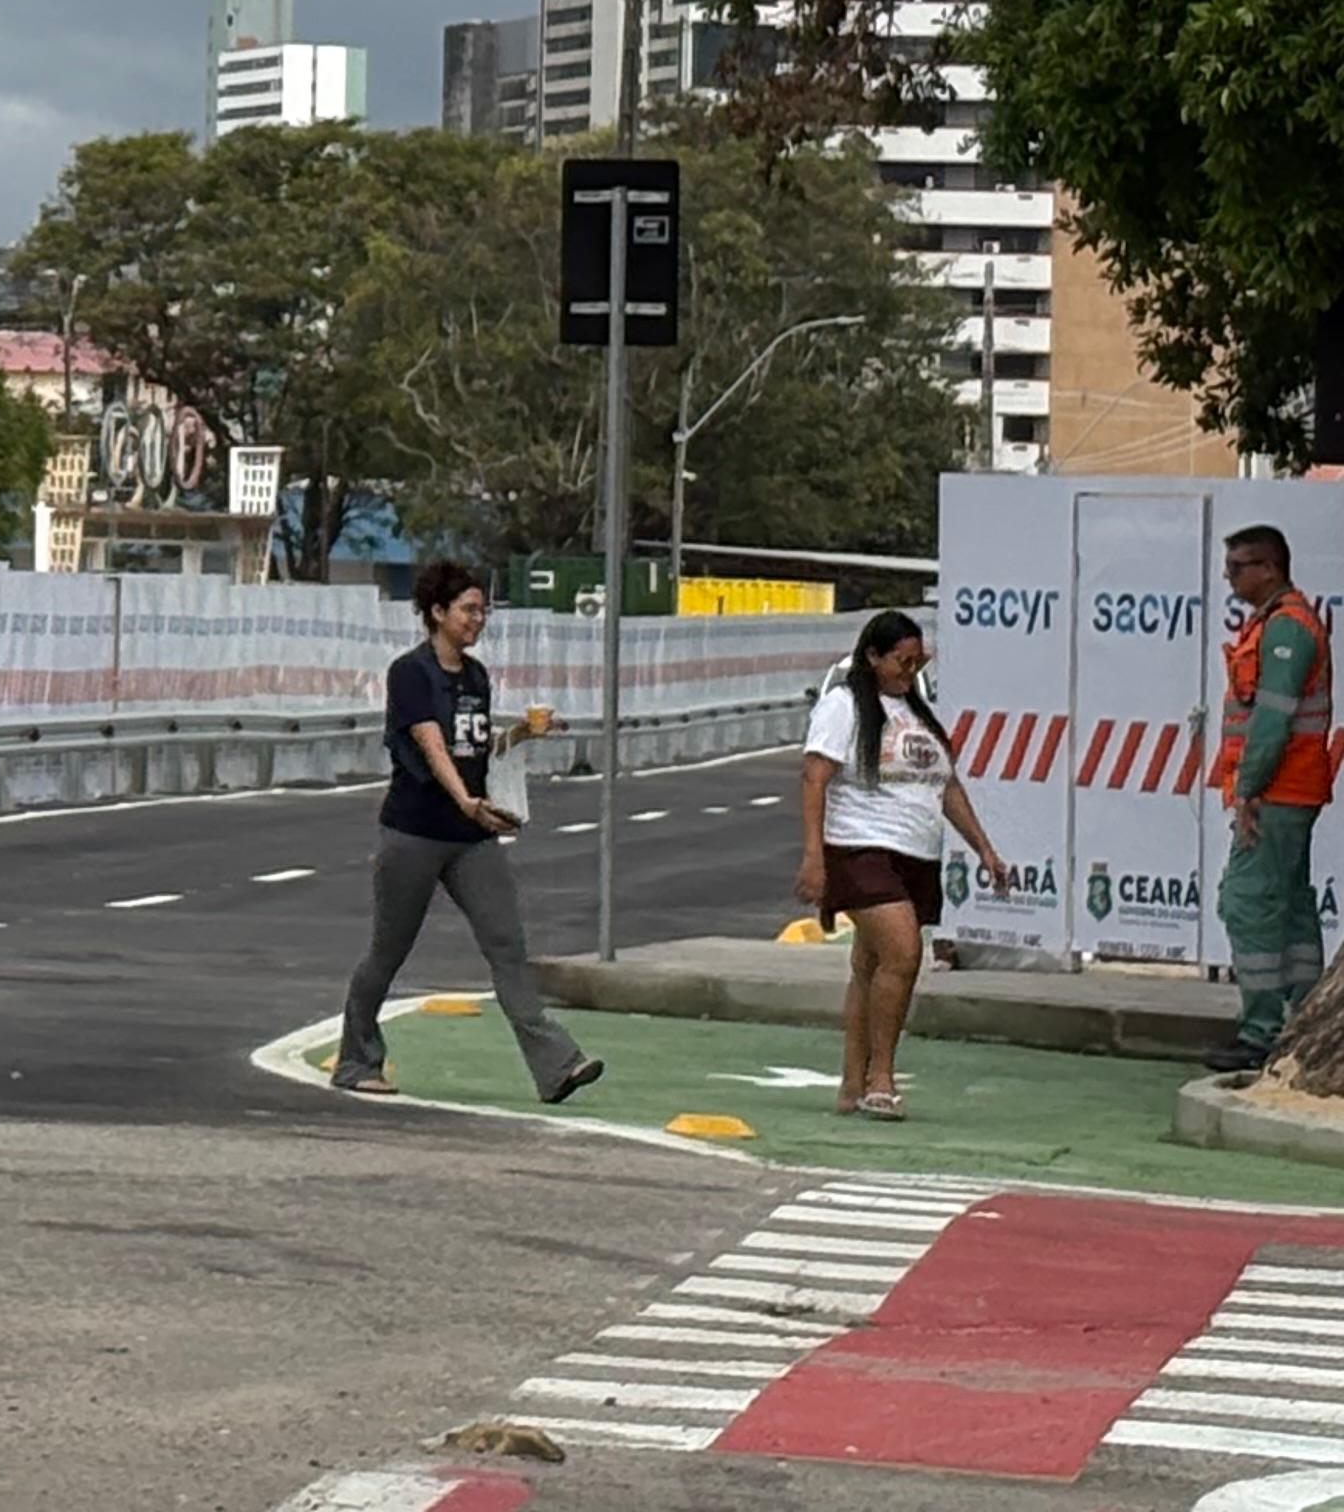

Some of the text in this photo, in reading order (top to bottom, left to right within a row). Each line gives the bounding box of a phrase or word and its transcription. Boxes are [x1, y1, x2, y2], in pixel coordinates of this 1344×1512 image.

[954, 587, 1059, 634] sacyr
[1092, 592, 1201, 640] sacyr
[976, 857, 1058, 895] CARÁ
[1119, 869, 1200, 908] CEARÁ
